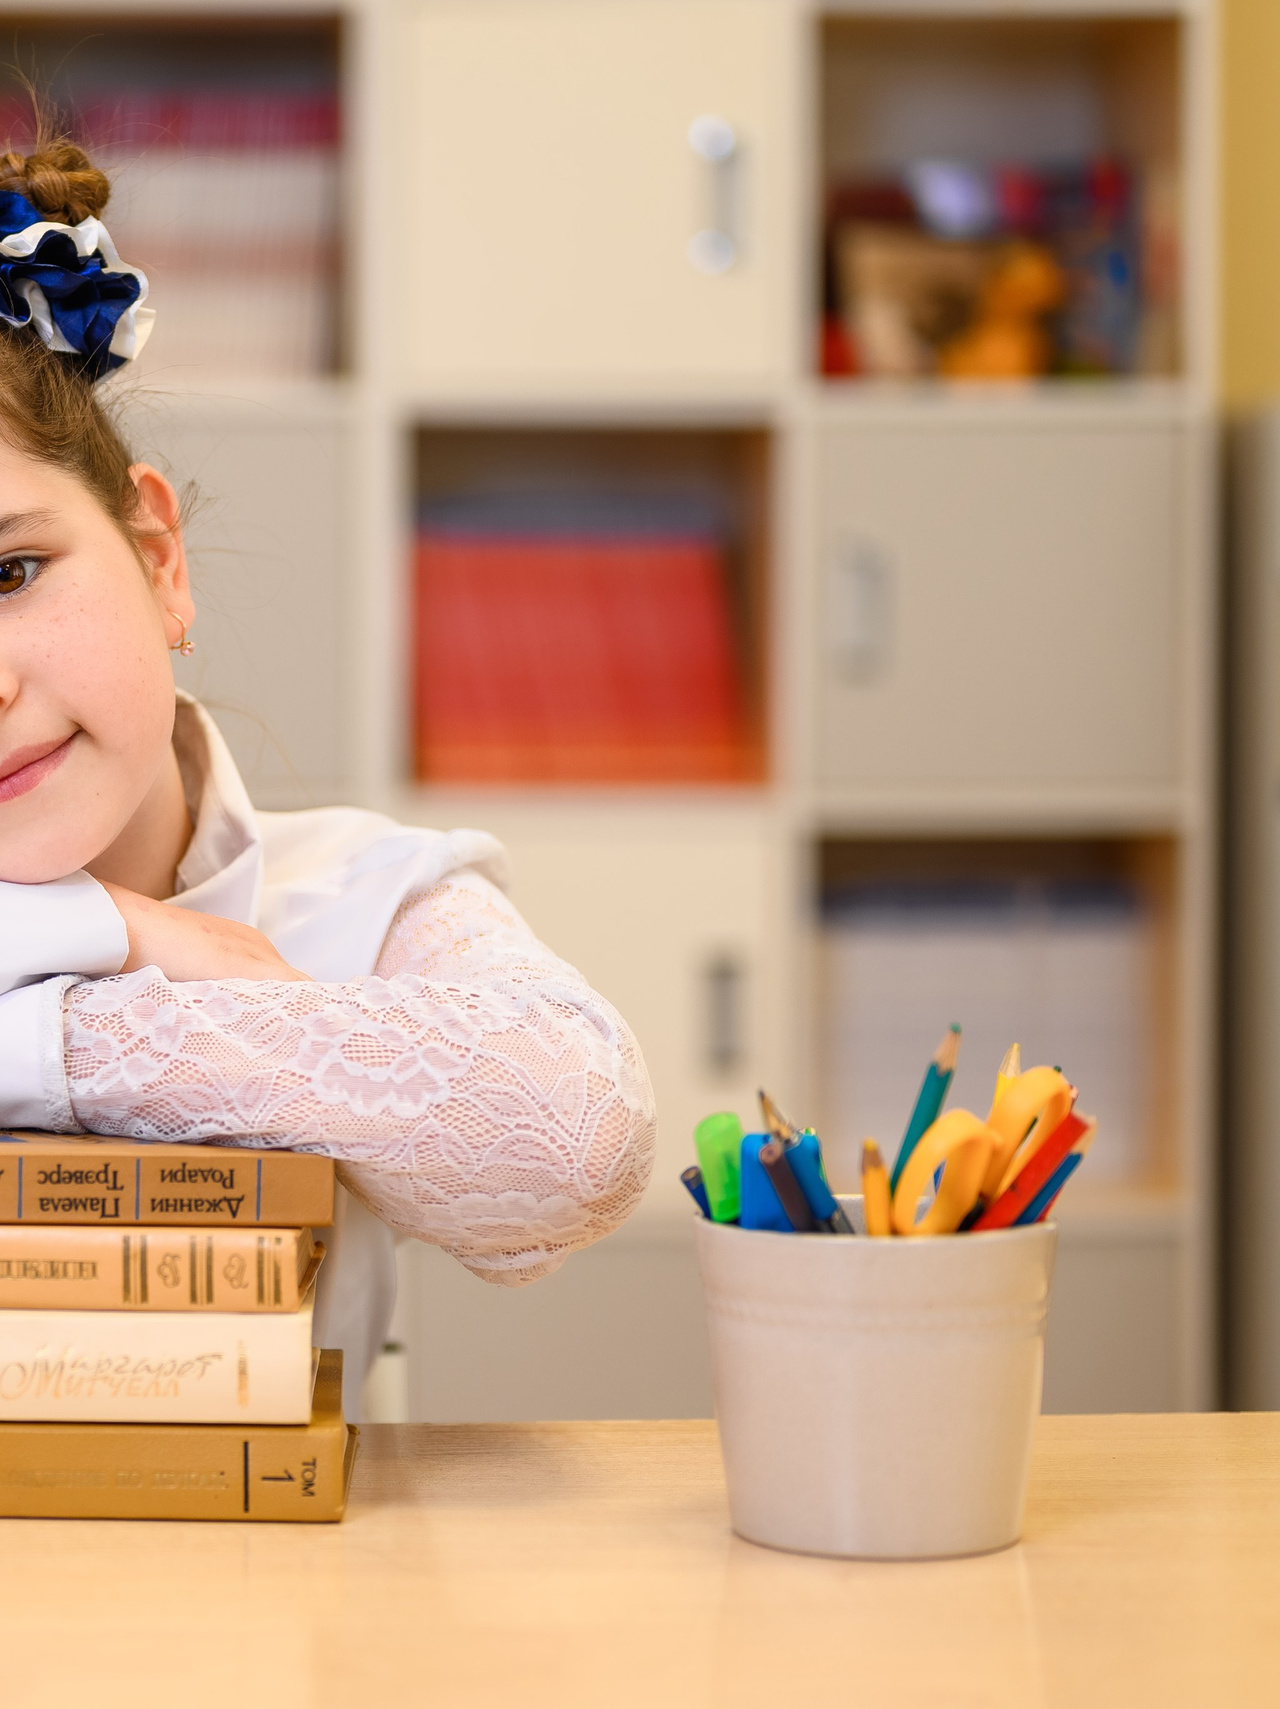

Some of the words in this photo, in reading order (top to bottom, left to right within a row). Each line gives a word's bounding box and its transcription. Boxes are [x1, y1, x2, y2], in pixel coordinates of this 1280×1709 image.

[37, 1162, 125, 1191] Трэверс
[160, 1162, 235, 1190] Родари
[38, 1196, 121, 1219] Памела
[150, 1195, 246, 1219] Джанни
[261, 1468, 296, 1483] 1
[301, 1457, 317, 1498] ТОМ
